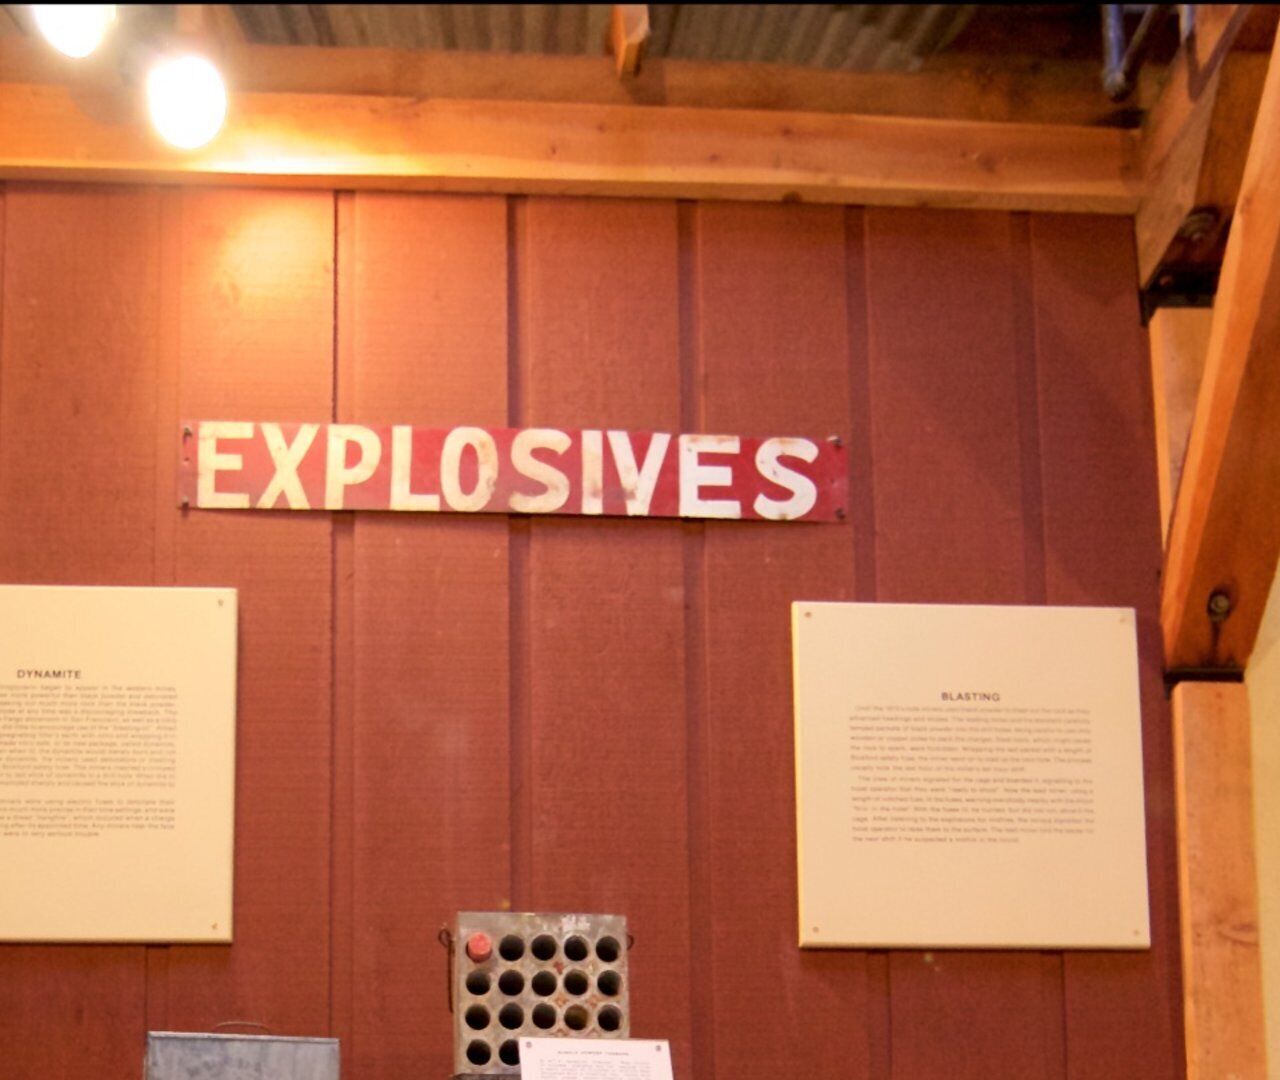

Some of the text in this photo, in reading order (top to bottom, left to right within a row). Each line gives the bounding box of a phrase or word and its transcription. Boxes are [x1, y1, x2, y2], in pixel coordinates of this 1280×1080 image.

[196, 420, 819, 520] EXPLOSIVES
[16, 669, 81, 679] DYNAMITE
[941, 691, 1001, 701] BLASTING
